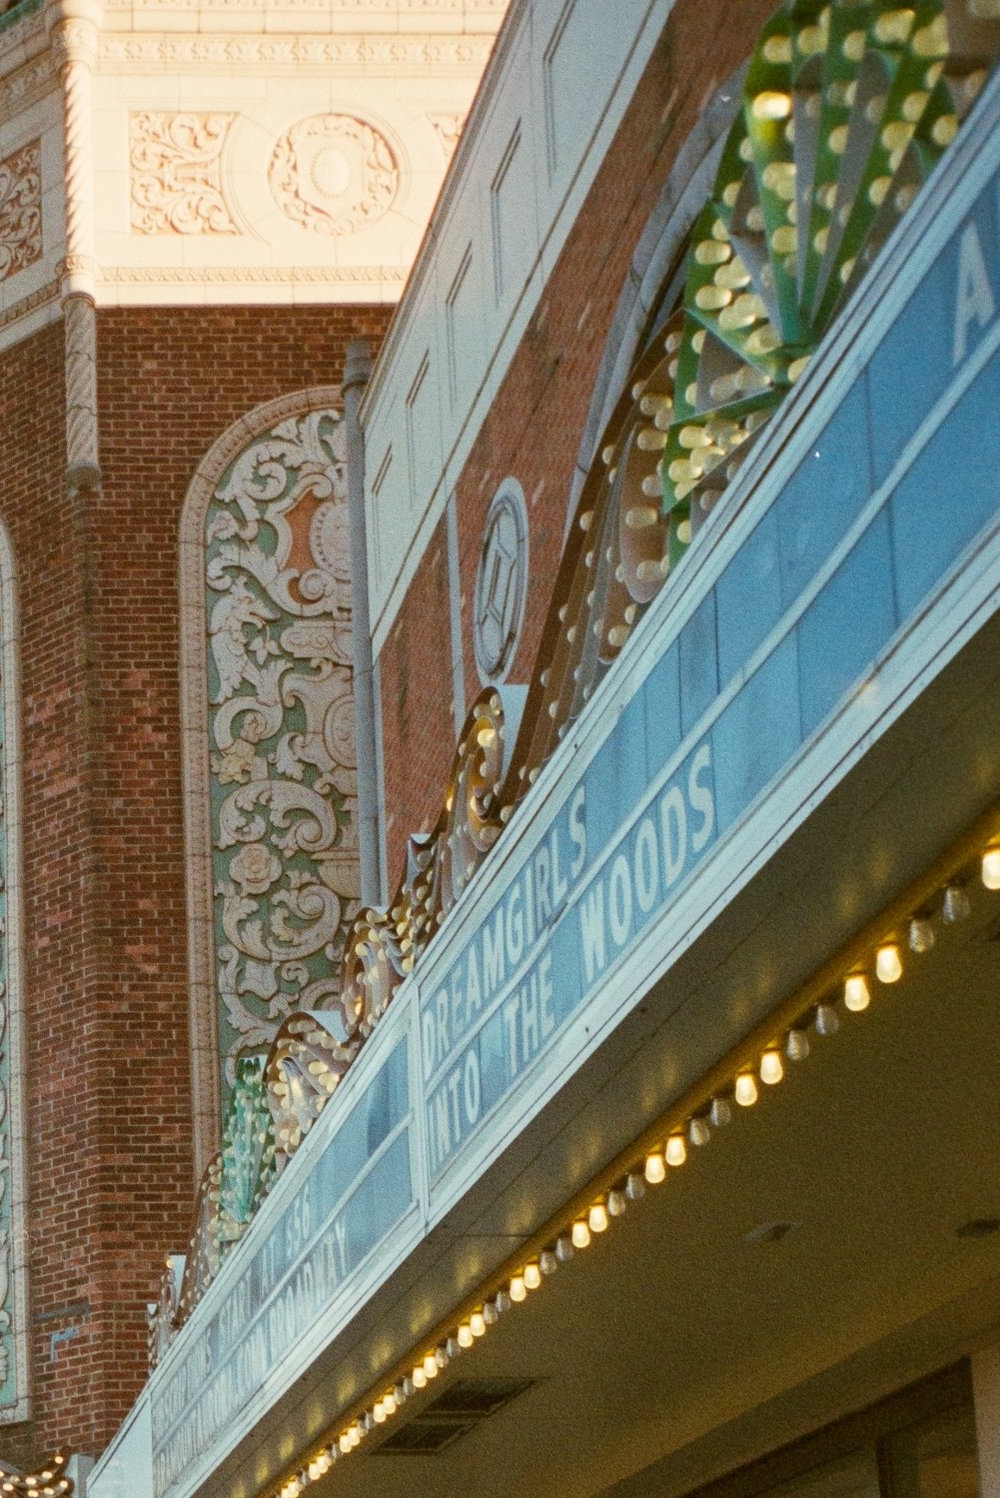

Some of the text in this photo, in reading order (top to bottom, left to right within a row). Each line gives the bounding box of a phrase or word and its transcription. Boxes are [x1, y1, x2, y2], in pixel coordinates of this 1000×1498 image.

[422, 784, 588, 1082] DREAMGIRLS
[427, 743, 716, 1174] INTO THE WOODS
[218, 1266, 252, 1358] START
[260, 1232, 276, 1299] AT
